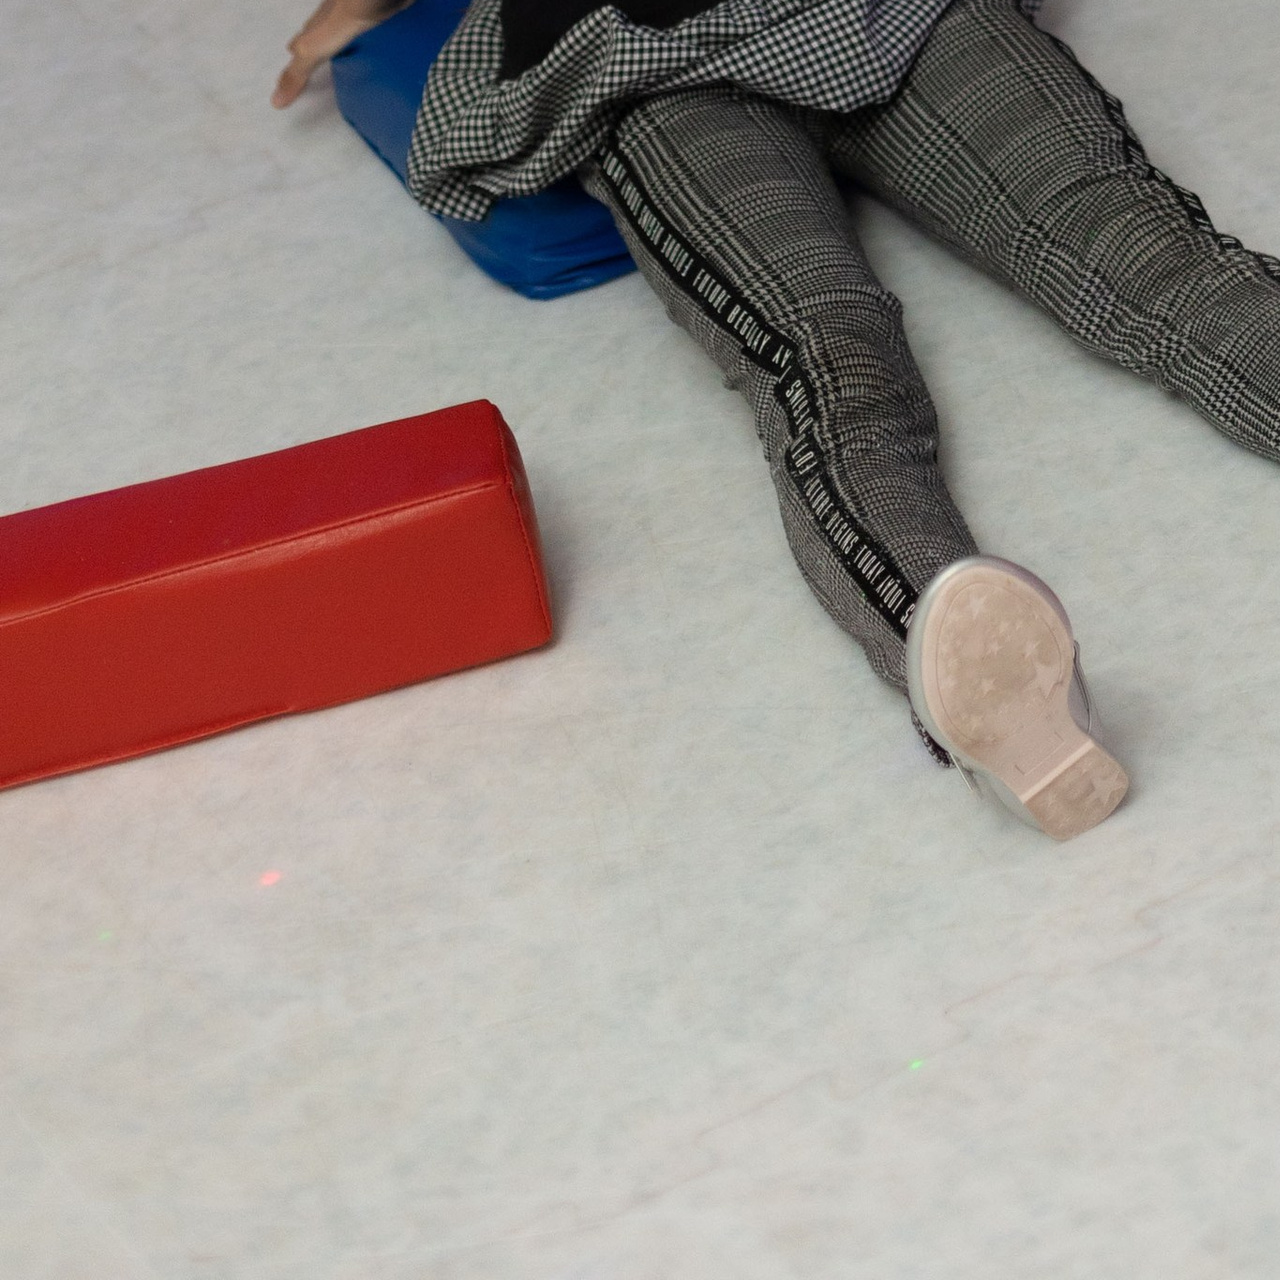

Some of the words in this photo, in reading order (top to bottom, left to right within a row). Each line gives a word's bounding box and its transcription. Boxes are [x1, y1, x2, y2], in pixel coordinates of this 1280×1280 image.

[692, 268, 732, 314] FUTURE
[825, 510, 860, 555] BEGINS
[853, 544, 886, 586] TODAY
[875, 575, 907, 614] TODAY
